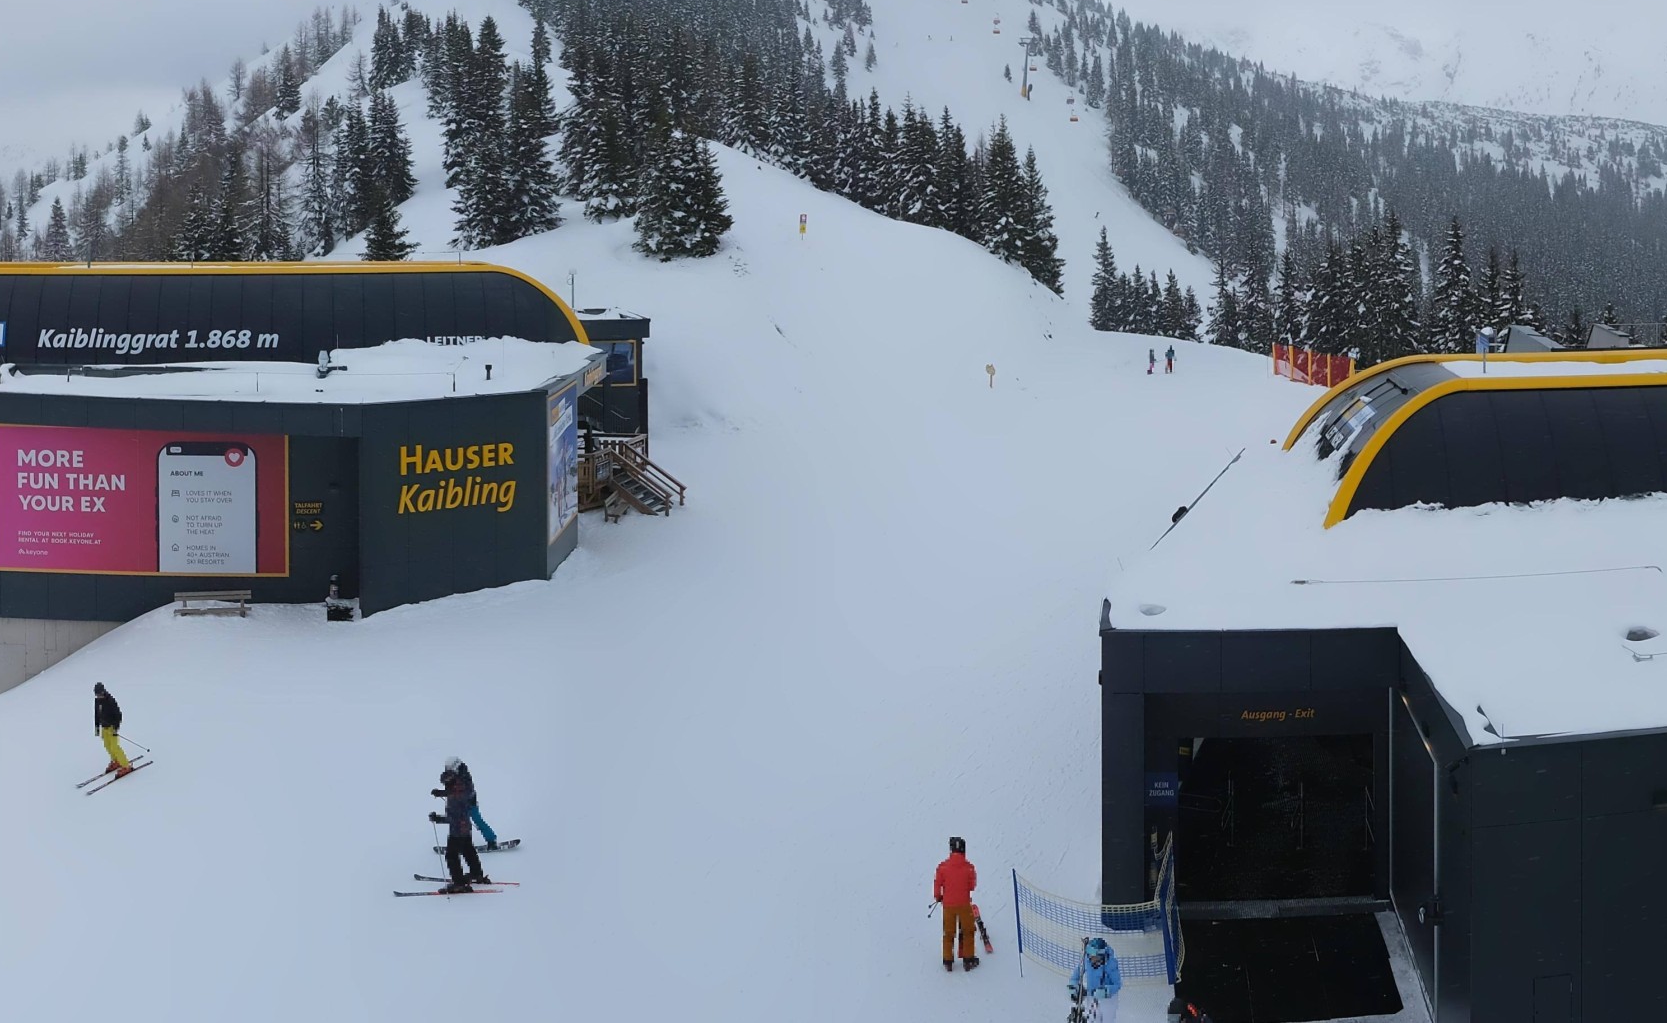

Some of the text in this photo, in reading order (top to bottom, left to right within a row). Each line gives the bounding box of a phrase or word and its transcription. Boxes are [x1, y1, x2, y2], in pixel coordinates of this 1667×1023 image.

[37, 327, 280, 354] Kaiblinggrat 1.868 m
[17, 449, 84, 468] MORE
[400, 442, 514, 476] HAUSER
[17, 472, 125, 491] FUN THAN
[18, 495, 106, 512] YOUR EX
[398, 476, 517, 514] Kaibling
[1241, 710, 1286, 722] Ausgang
[1295, 707, 1315, 718] Exit
